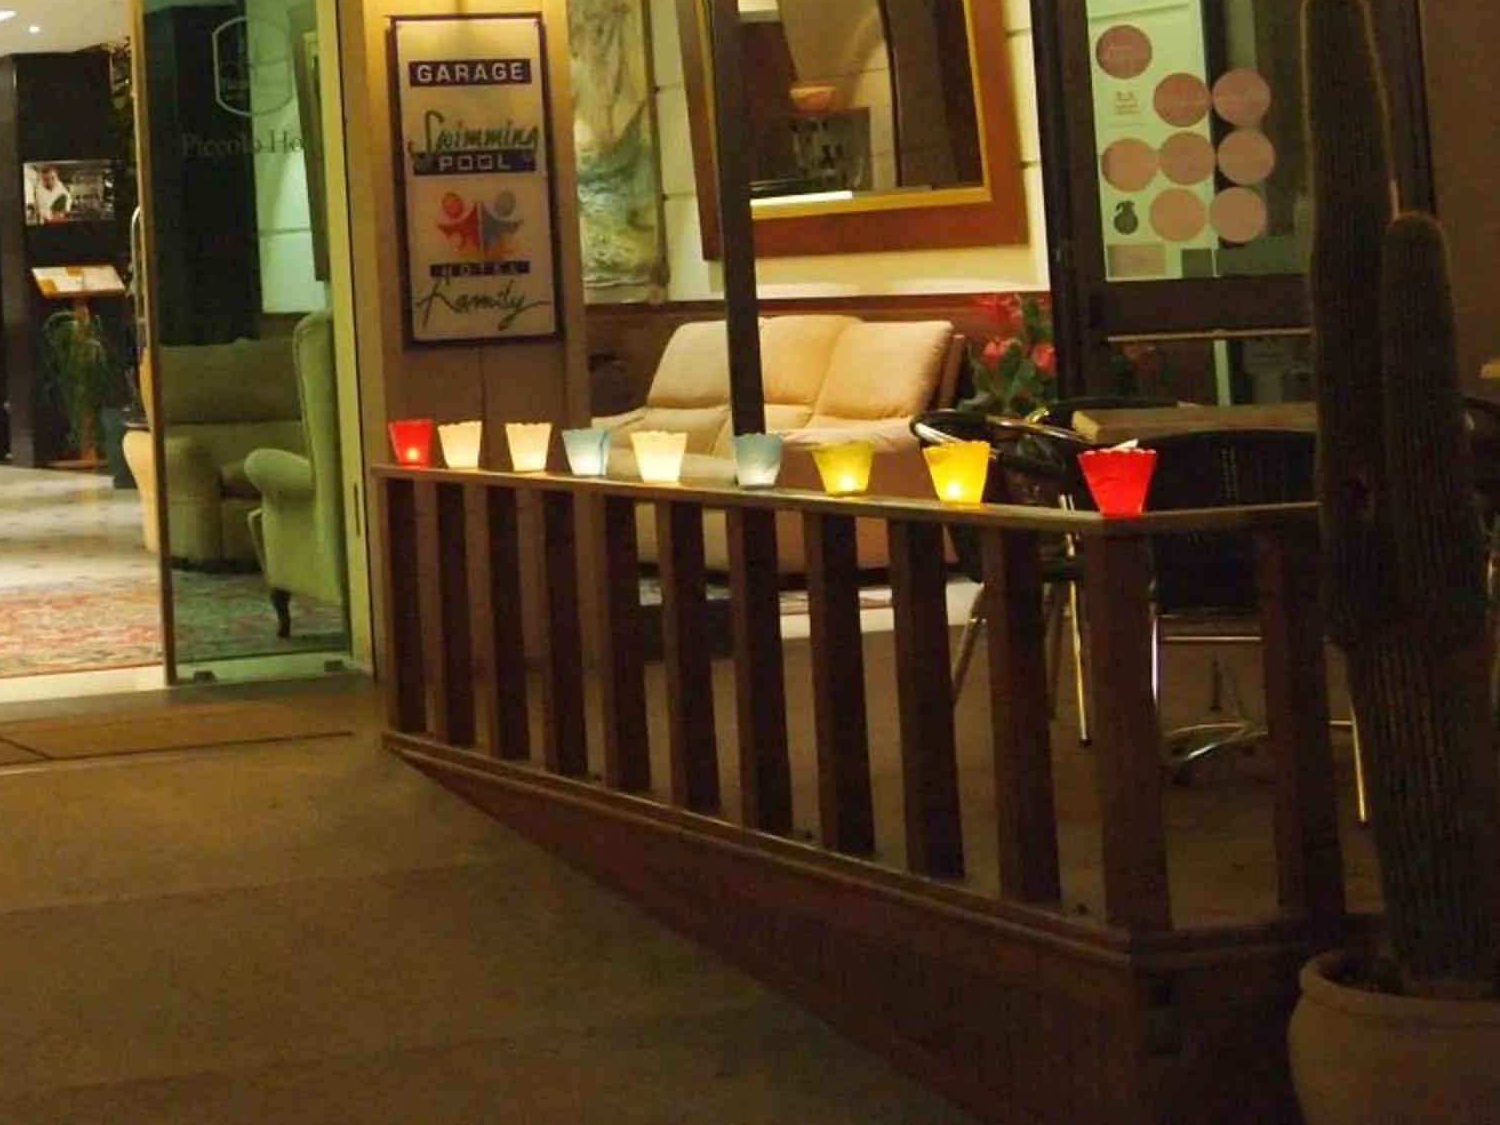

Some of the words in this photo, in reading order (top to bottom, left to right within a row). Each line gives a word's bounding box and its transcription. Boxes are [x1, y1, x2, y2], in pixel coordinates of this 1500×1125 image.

[416, 61, 524, 84] GARAGE
[408, 110, 539, 163] Swimming
[438, 153, 512, 172] POOL
